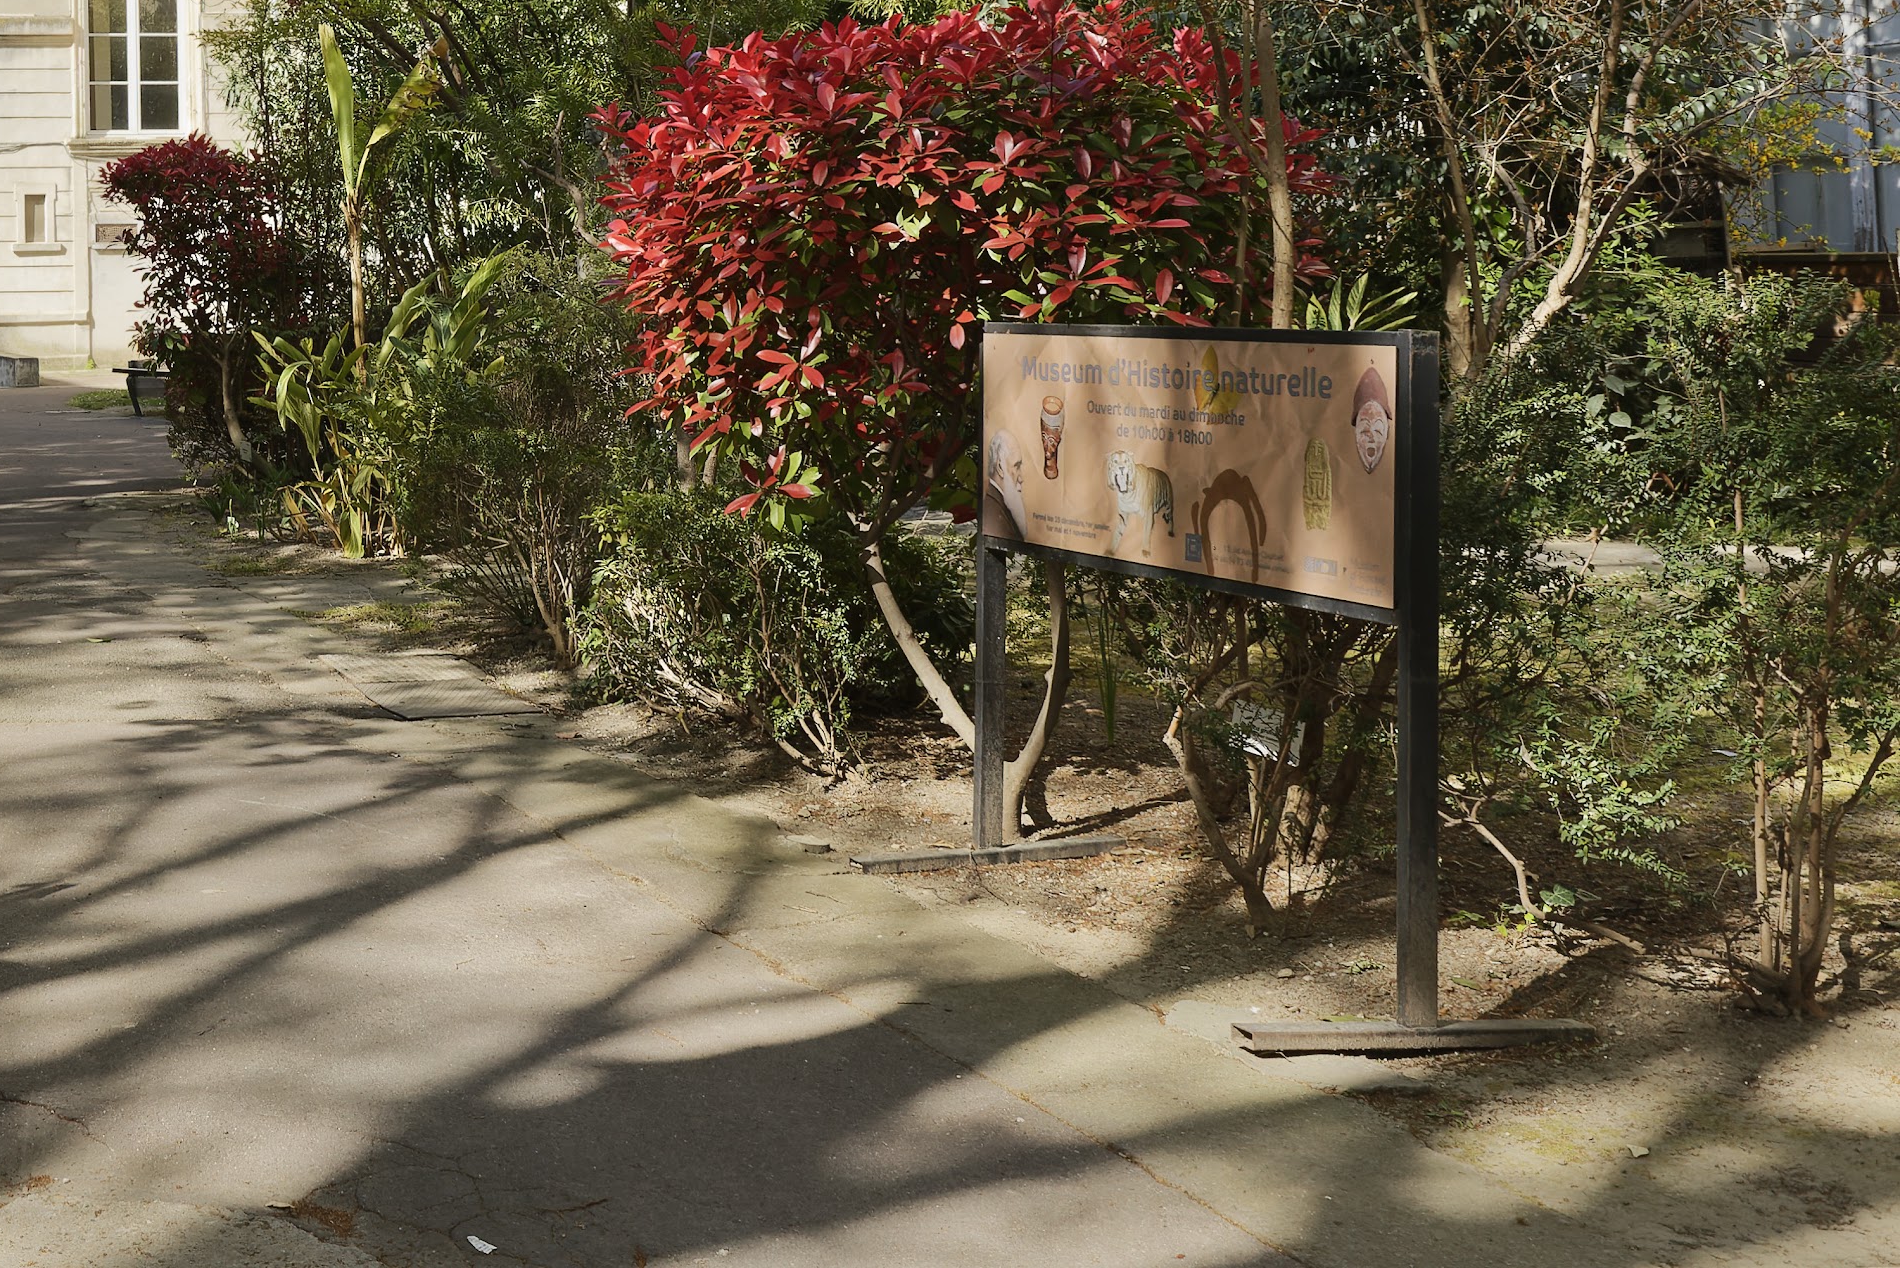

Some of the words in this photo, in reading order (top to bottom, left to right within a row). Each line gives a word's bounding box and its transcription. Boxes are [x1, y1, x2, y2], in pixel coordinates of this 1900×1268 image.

[1109, 358, 1214, 391] d'Histoire
[1221, 366, 1333, 399] naturelle
[1086, 400, 1122, 416] Ouvert
[1124, 403, 1137, 417] du
[1139, 404, 1171, 420] mardi
[1173, 409, 1187, 422] au
[1189, 407, 1245, 426] dimanche
[1116, 423, 1130, 437] de
[1132, 426, 1166, 442] 10h00
[1177, 429, 1213, 446] 18h00
